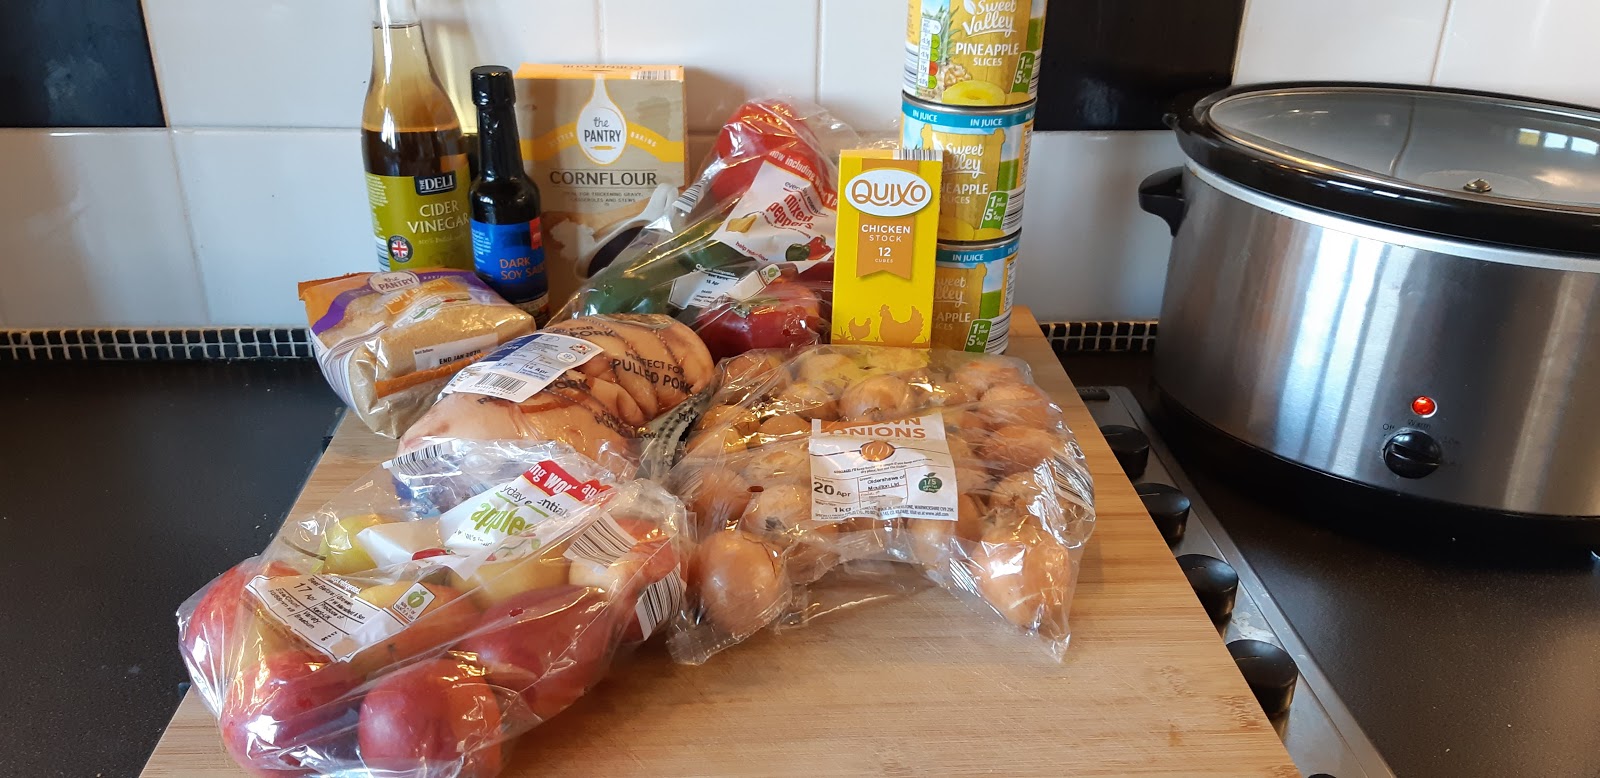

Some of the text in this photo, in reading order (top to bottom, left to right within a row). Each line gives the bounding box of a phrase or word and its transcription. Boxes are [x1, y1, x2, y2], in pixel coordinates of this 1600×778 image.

[977, 0, 1016, 15] Sweet
[962, 9, 1014, 37] Valley
[955, 42, 1019, 56] PINEAPPLE
[972, 57, 1003, 66] SLICES
[593, 116, 609, 128] the
[912, 109, 938, 122] IN JUICE
[981, 118, 1002, 127] JUICE
[584, 129, 621, 142] PANTRY
[630, 131, 657, 147] BAKING
[945, 142, 984, 156] Sweet
[943, 154, 981, 178] alley
[425, 174, 454, 190] DELI
[550, 170, 657, 186] CORNFLOUR
[851, 179, 926, 206] QUIXO
[784, 194, 814, 222] mixed
[990, 195, 996, 208] 1
[420, 200, 460, 217] CIDER
[985, 208, 994, 220] 5
[766, 202, 814, 230] peppers
[407, 213, 470, 234] VINEGAR
[862, 224, 910, 234] CHICKEN
[869, 234, 902, 242] STOCK
[878, 247, 892, 256] 12
[962, 254, 984, 262] JUICE
[500, 256, 530, 268] DARK
[500, 270, 522, 280] SOY
[378, 277, 414, 290] PANTRY
[972, 323, 979, 334] 1
[968, 335, 976, 346] 5
[439, 356, 452, 364] END
[611, 358, 694, 394] PULLED PORK
[668, 363, 684, 376] FOR
[554, 378, 591, 392] ORK
[814, 482, 834, 496] 20
[294, 582, 312, 592] 17
